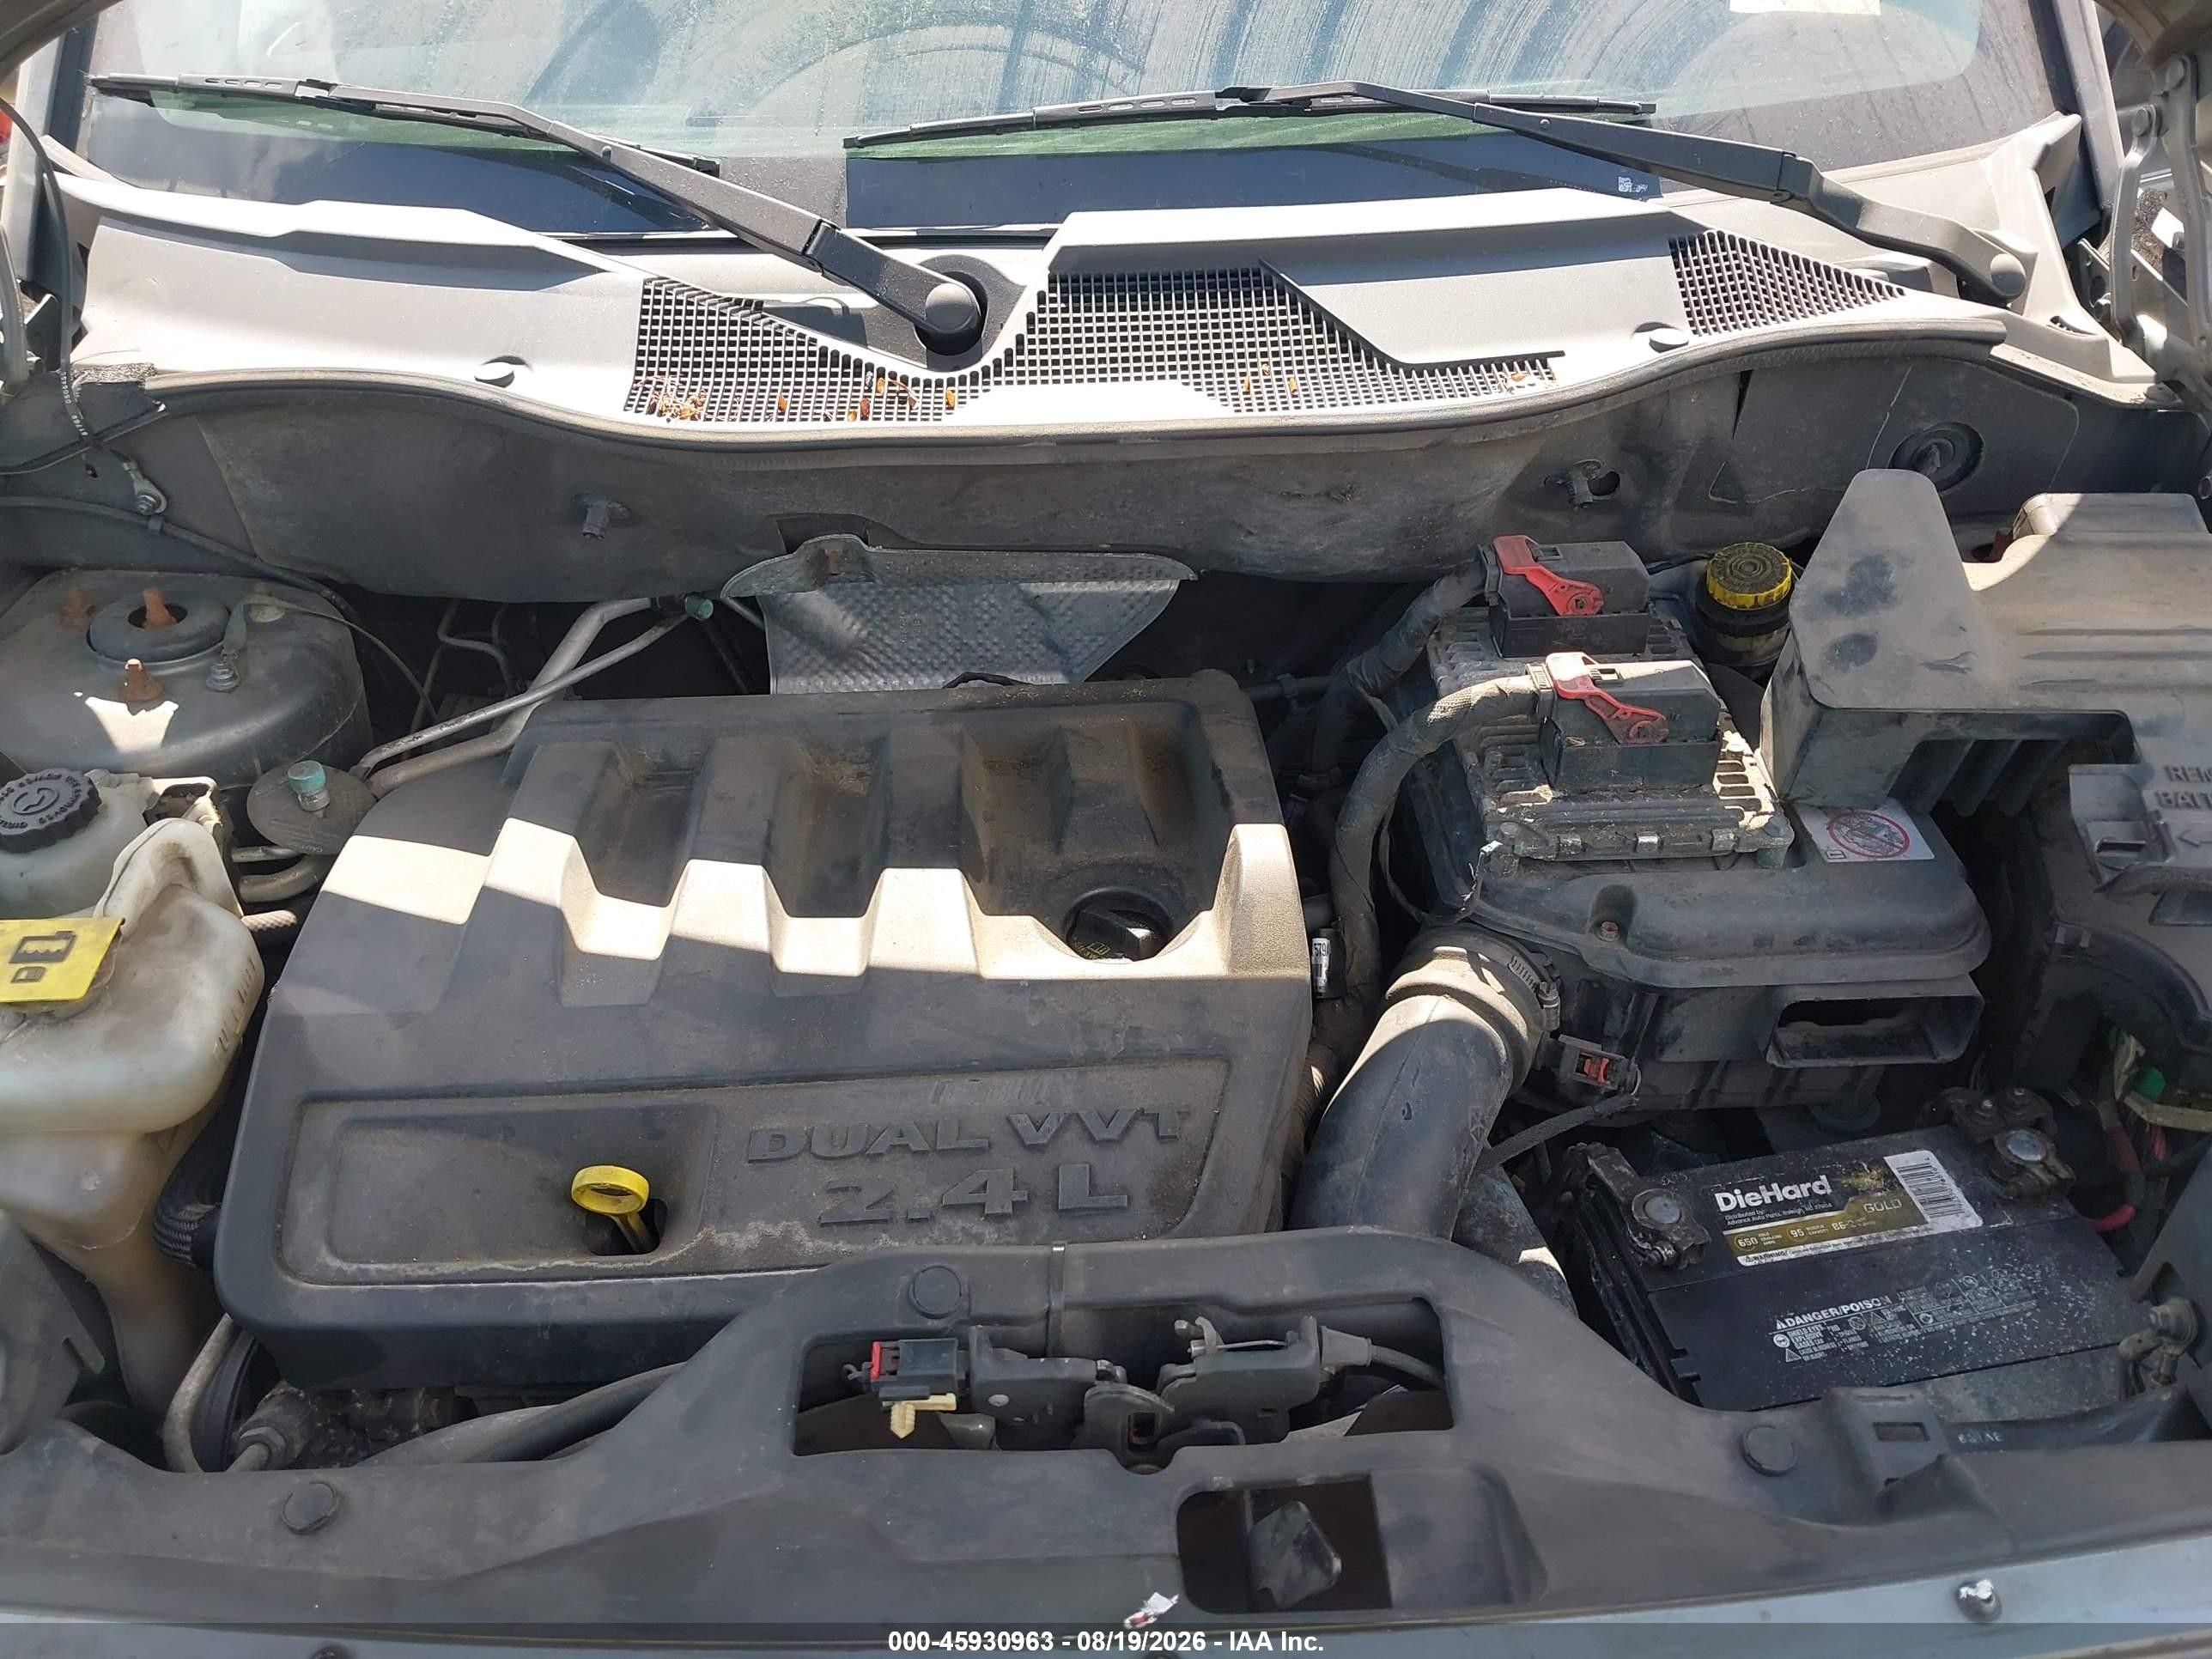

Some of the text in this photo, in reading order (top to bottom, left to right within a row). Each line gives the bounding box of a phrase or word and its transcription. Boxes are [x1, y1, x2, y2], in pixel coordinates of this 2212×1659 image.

[747, 1107, 1191, 1163] DUAL VVT
[1714, 1175, 1832, 1212] DieHard
[1863, 1199, 1903, 1213] GOLD
[1727, 1218, 1751, 1226] Advance
[1790, 1229, 1805, 1238] 95
[1737, 1237, 1759, 1248] 650
